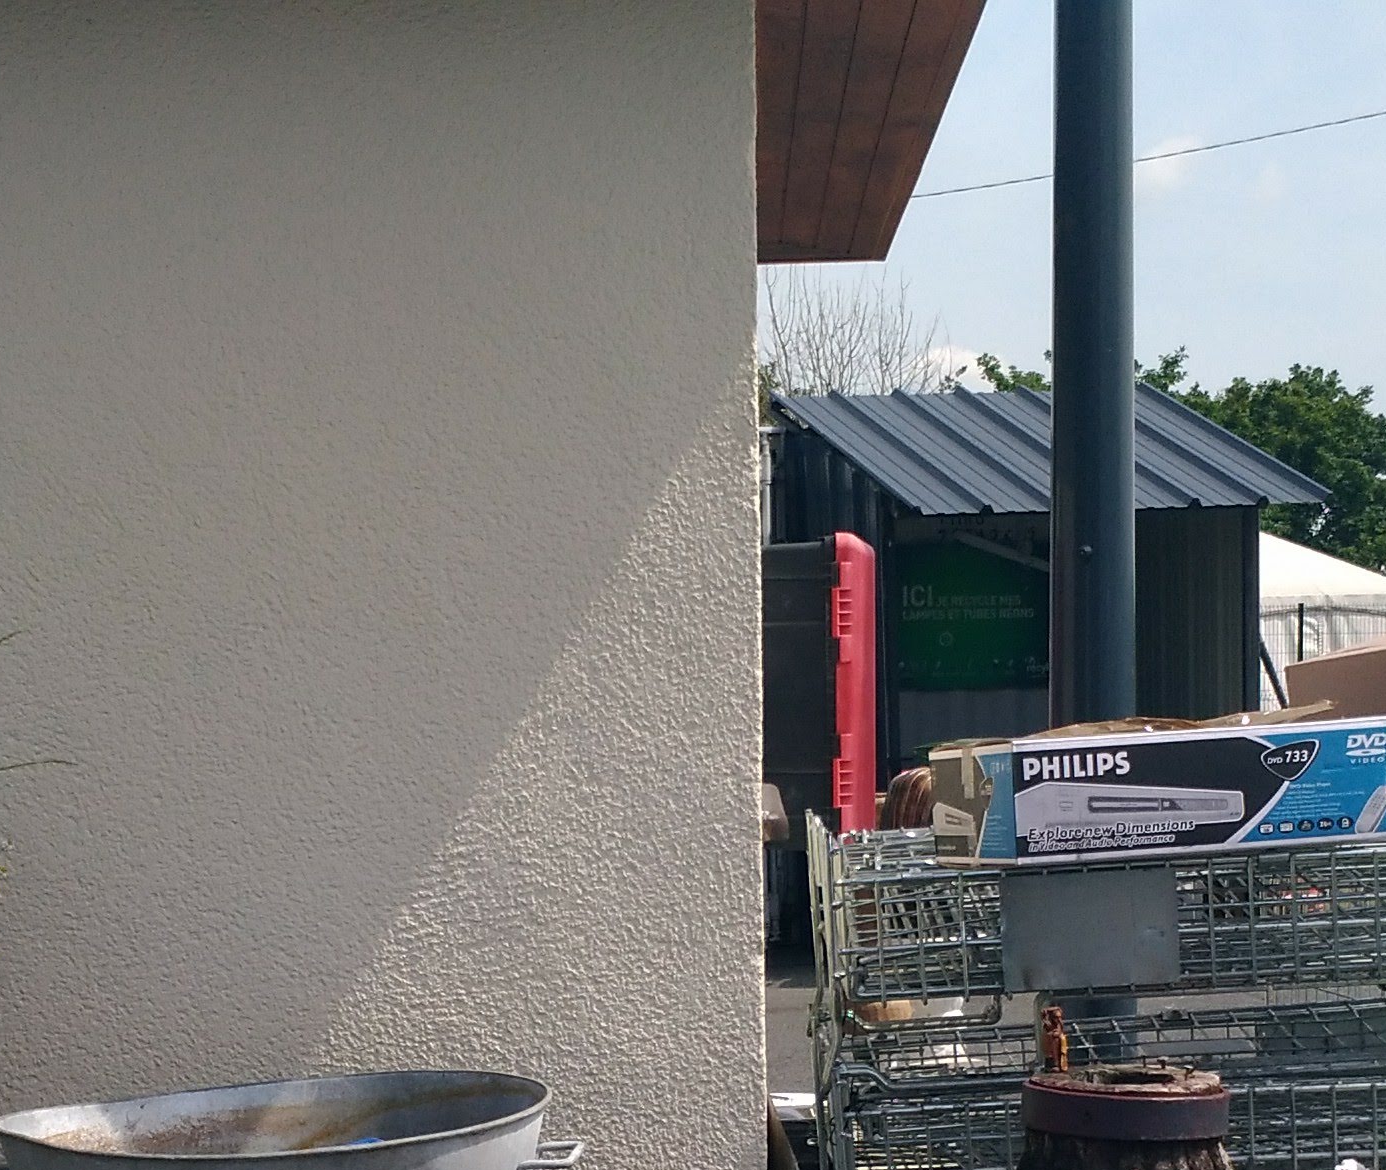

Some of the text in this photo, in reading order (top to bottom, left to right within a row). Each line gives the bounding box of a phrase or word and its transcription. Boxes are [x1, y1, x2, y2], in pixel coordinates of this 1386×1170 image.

[903, 585, 933, 607] ICI
[1022, 751, 1131, 781] PHILIPS
[1267, 750, 1309, 765] DVD 733
[1028, 826, 1083, 842] Explore
[1084, 826, 1113, 838] new
[1115, 819, 1195, 835] Dimensions
[1114, 834, 1175, 848] Performance
